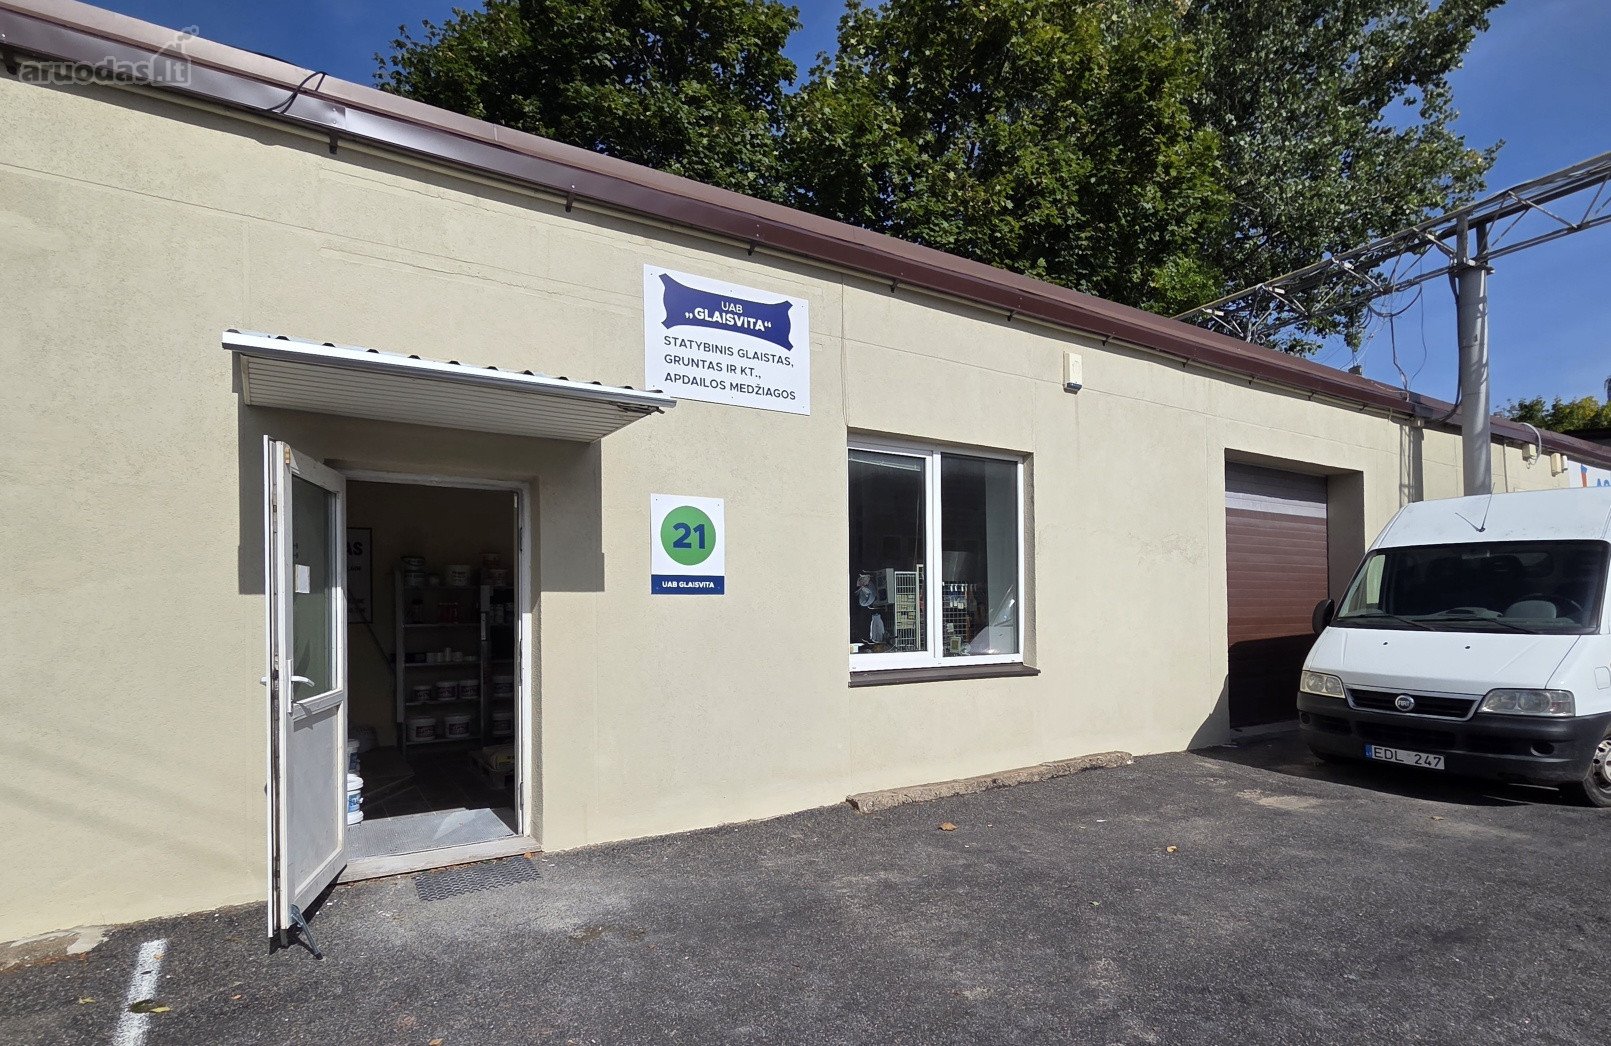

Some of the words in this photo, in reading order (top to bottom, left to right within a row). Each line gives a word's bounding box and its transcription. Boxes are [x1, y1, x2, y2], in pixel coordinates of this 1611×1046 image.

[721, 301, 743, 314] UAB
[664, 335, 734, 356] STATYBINIS
[737, 348, 794, 368] GLAISTAS,
[664, 354, 723, 372] GRUNTAS
[726, 363, 737, 374] IR
[664, 372, 726, 390] APDAILOS
[729, 382, 796, 400] MEDŽIAGOS
[672, 522, 706, 550] 21
[1374, 747, 1404, 762] EDL
[1414, 753, 1442, 767] 247
